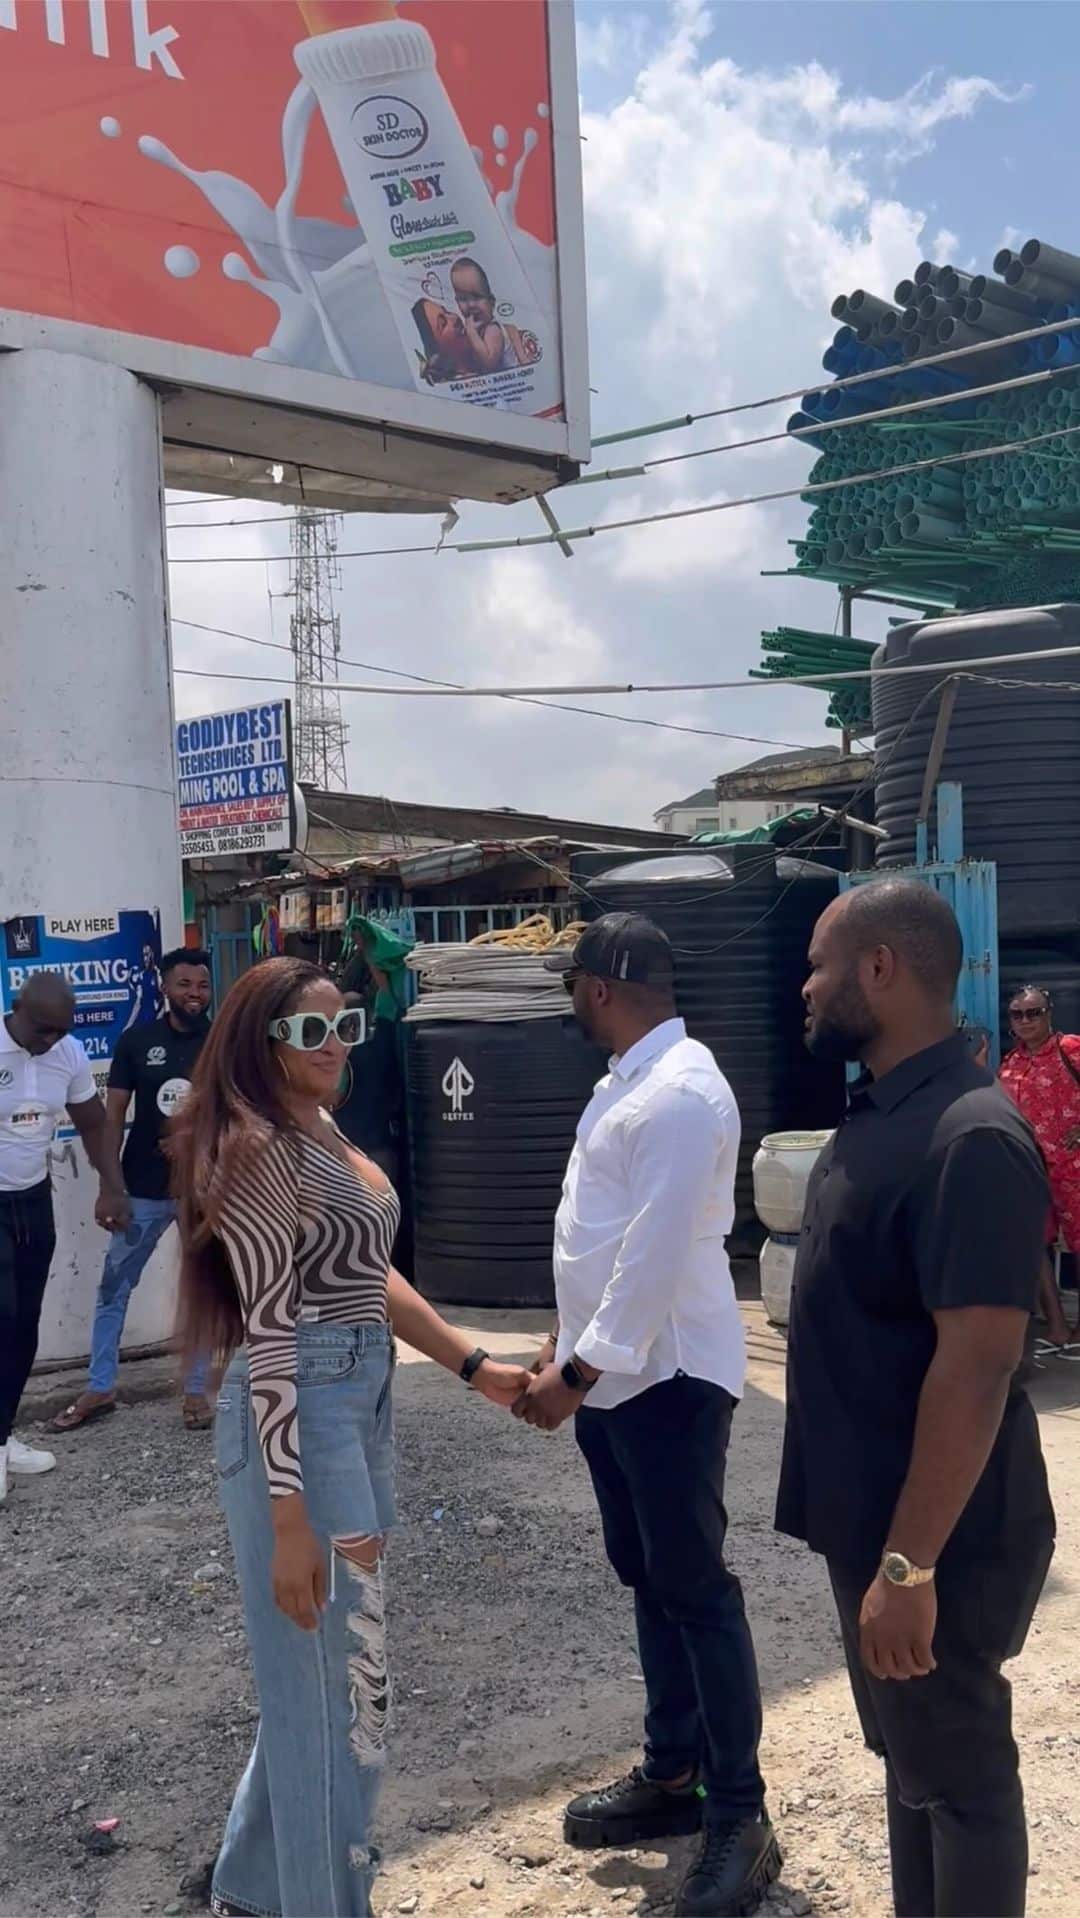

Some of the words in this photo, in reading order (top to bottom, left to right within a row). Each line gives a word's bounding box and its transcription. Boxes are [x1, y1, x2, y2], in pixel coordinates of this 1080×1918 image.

[376, 112, 400, 131] SD
[385, 127, 423, 142] DOCTOR
[382, 174, 444, 207] BABY
[177, 703, 283, 753] GODDYBEST
[180, 744, 255, 776] TECHSERVICES
[213, 771, 245, 800] POOL
[250, 771, 259, 795] &
[262, 766, 286, 793] SPA
[51, 919, 81, 933] PLAY
[84, 917, 115, 931] HERE
[74, 1014, 84, 1023] IS
[86, 1011, 114, 1022] HERE
